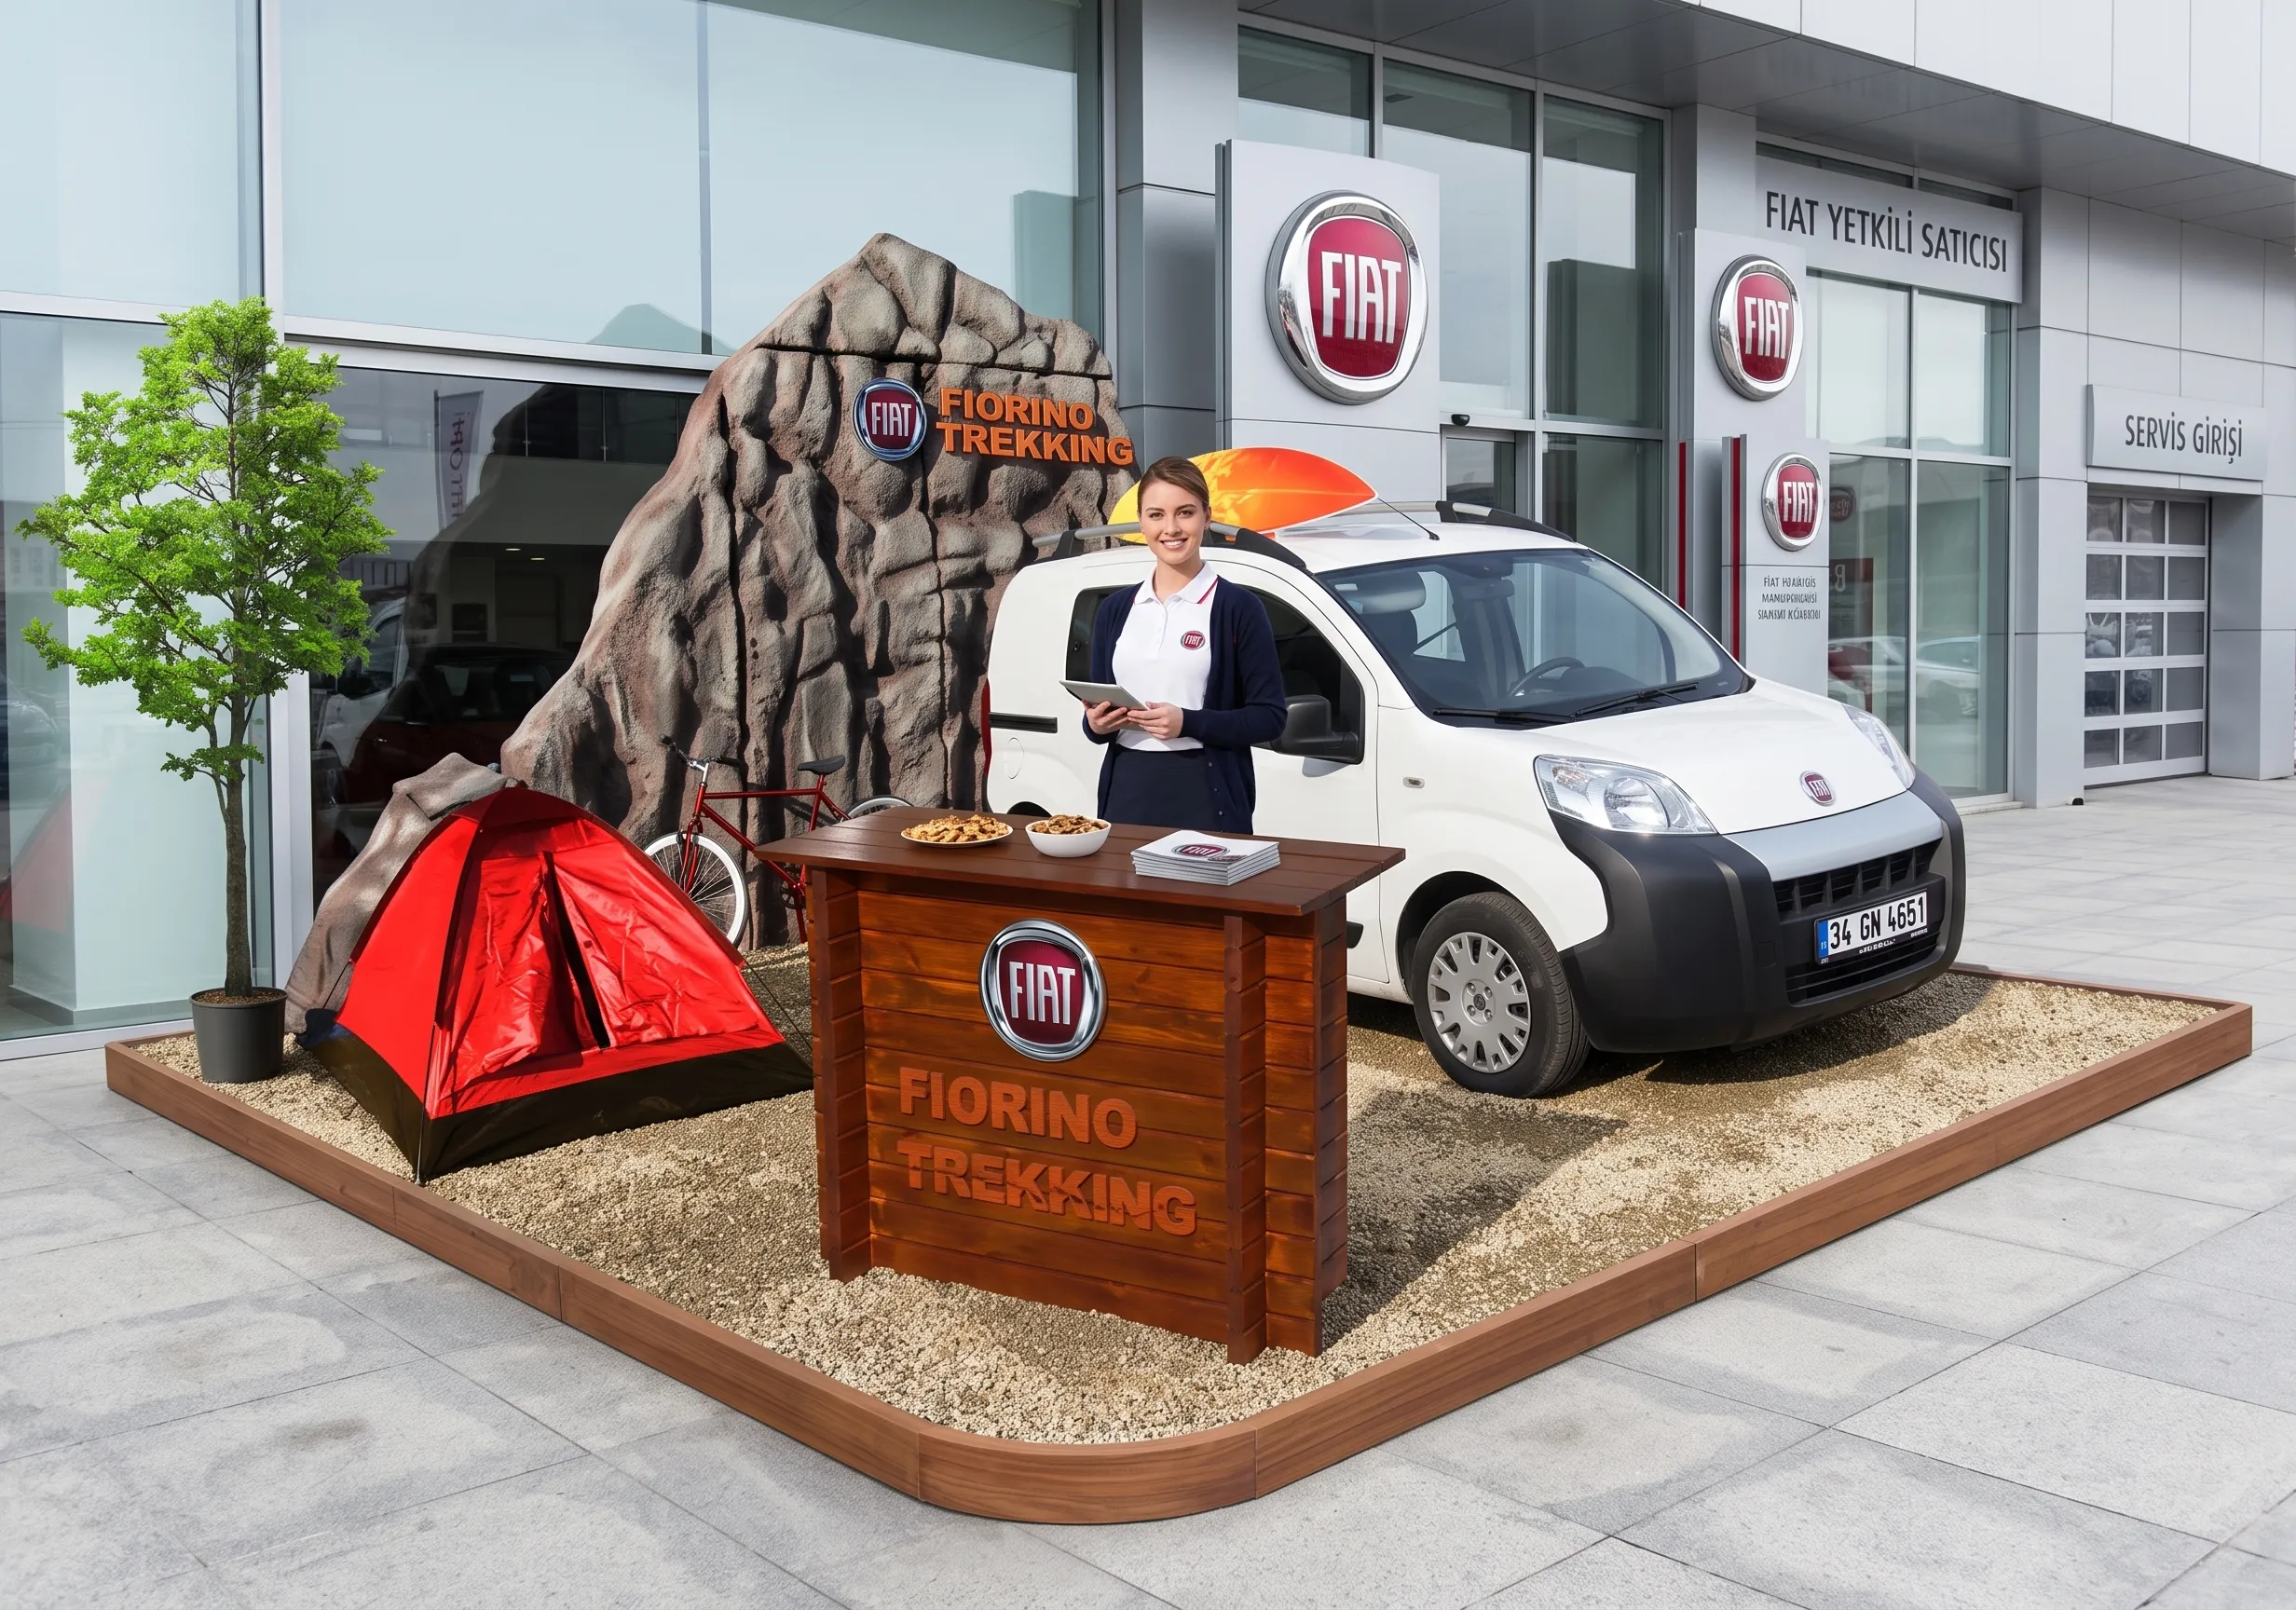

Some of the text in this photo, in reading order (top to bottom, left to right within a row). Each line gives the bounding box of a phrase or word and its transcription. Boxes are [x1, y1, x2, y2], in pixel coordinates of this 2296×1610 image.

[1767, 191, 2006, 273] FIAT YETKİLİ SATICISI
[1320, 251, 1401, 344] FIAT
[1743, 296, 1789, 359] FIAT
[870, 402, 912, 437] FIAT
[939, 388, 1094, 430] FIORINO
[2125, 411, 2243, 464] SERVİS GİRİŞİ
[936, 421, 1134, 466] TREKKING
[1783, 481, 1814, 524] FIAT
[1829, 918, 1852, 949] 34
[1860, 908, 1881, 941] GN
[1888, 896, 1924, 932] 4651
[1008, 961, 1076, 1026] FIAT
[899, 1067, 1139, 1150] FIORINO
[897, 1140, 1197, 1237] TREKKING
